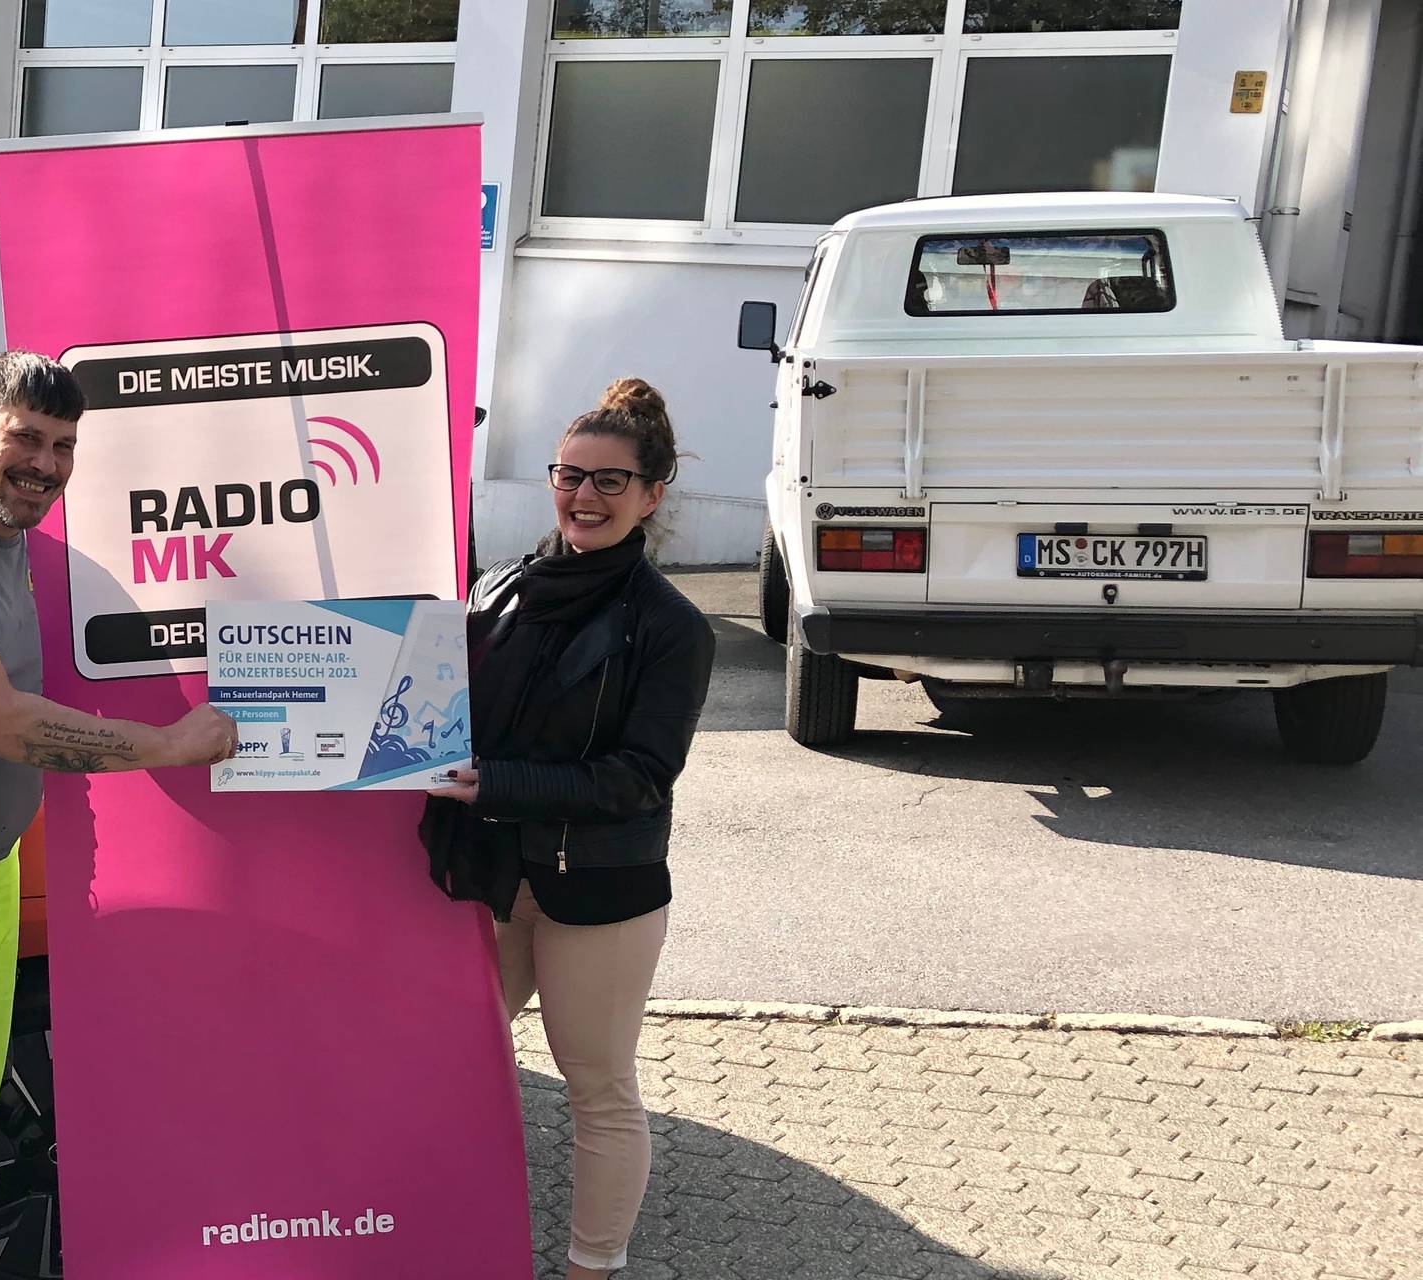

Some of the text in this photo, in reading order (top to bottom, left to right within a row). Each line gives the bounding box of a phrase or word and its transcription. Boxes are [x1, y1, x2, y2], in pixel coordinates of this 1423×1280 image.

[118, 353, 380, 395] DIE MEISTE MUSIK.
[129, 478, 320, 534] RADIO
[835, 506, 925, 517] VOLKSWAGEN
[131, 533, 237, 584] MK
[1024, 539, 1203, 567] D MS CK 797H
[150, 621, 205, 648] DER
[218, 625, 352, 645] GUTSCHEIN
[218, 650, 350, 663] FÜR EINEN OPEN-AIR-
[219, 667, 358, 678] KONZERTBESUCH 2021
[220, 690, 319, 700] im Sauerlandpark Hemer
[242, 710, 279, 718] Personen
[202, 1208, 395, 1246] radiomk.de
